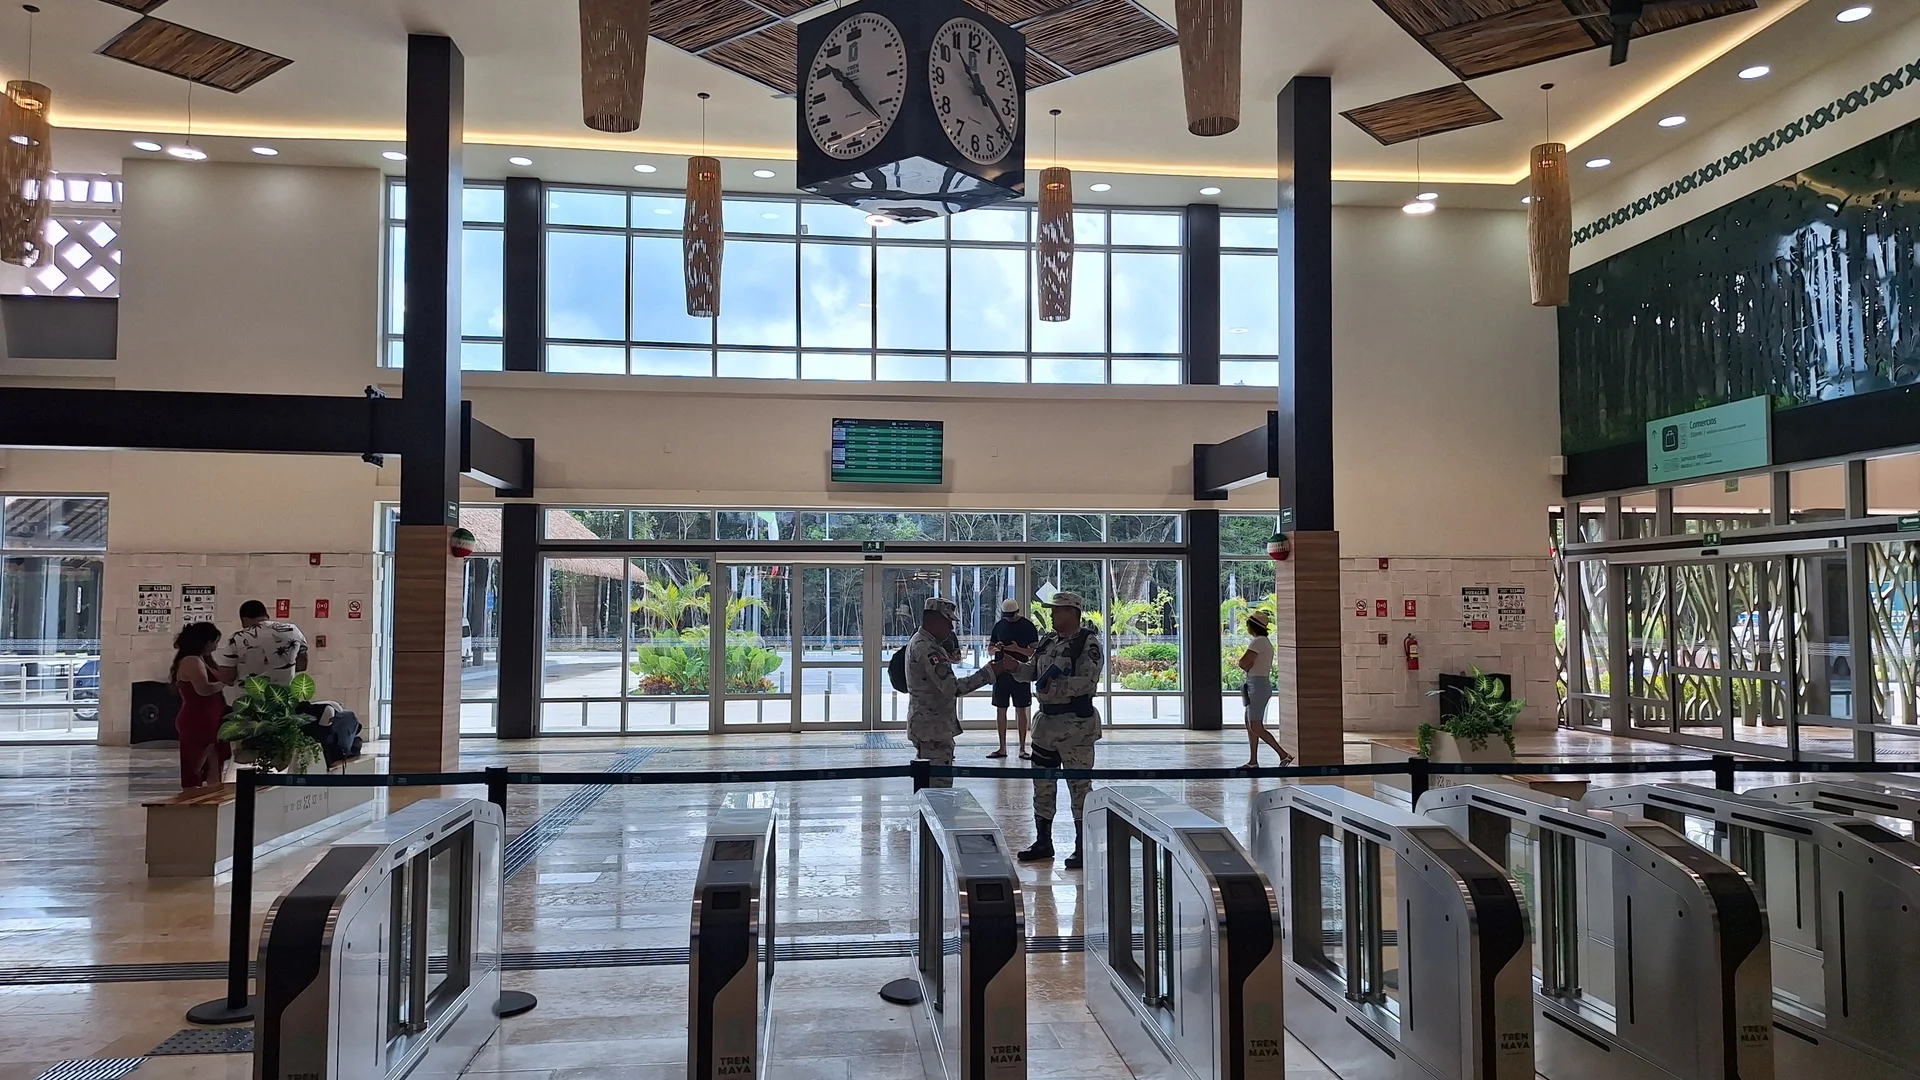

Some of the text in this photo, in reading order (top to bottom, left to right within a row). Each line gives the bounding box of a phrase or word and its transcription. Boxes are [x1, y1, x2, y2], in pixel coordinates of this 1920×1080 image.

[952, 31, 961, 50] 11
[968, 30, 982, 53] 12
[940, 43, 951, 63] 10
[987, 47, 992, 65] 1
[936, 67, 945, 85] 9
[997, 70, 1006, 88] 2
[942, 96, 951, 114] 8
[1002, 98, 1011, 116] 3
[956, 118, 965, 137] 7
[996, 124, 1005, 139] 4
[971, 134, 980, 153] 6
[986, 134, 995, 152] 5
[1689, 418, 1717, 429] Comercios
[1501, 1032, 1529, 1041] TREN
[1742, 1025, 1768, 1033] TREN
[1250, 1039, 1278, 1048] TREN
[1500, 1041, 1531, 1050] MAYA
[1741, 1034, 1769, 1042] MAYA
[992, 1045, 1021, 1054] TREN
[1248, 1048, 1280, 1057] MAYA
[720, 1056, 750, 1066] TREN
[990, 1054, 1022, 1064] MAYA
[718, 1065, 752, 1076] MAYA
